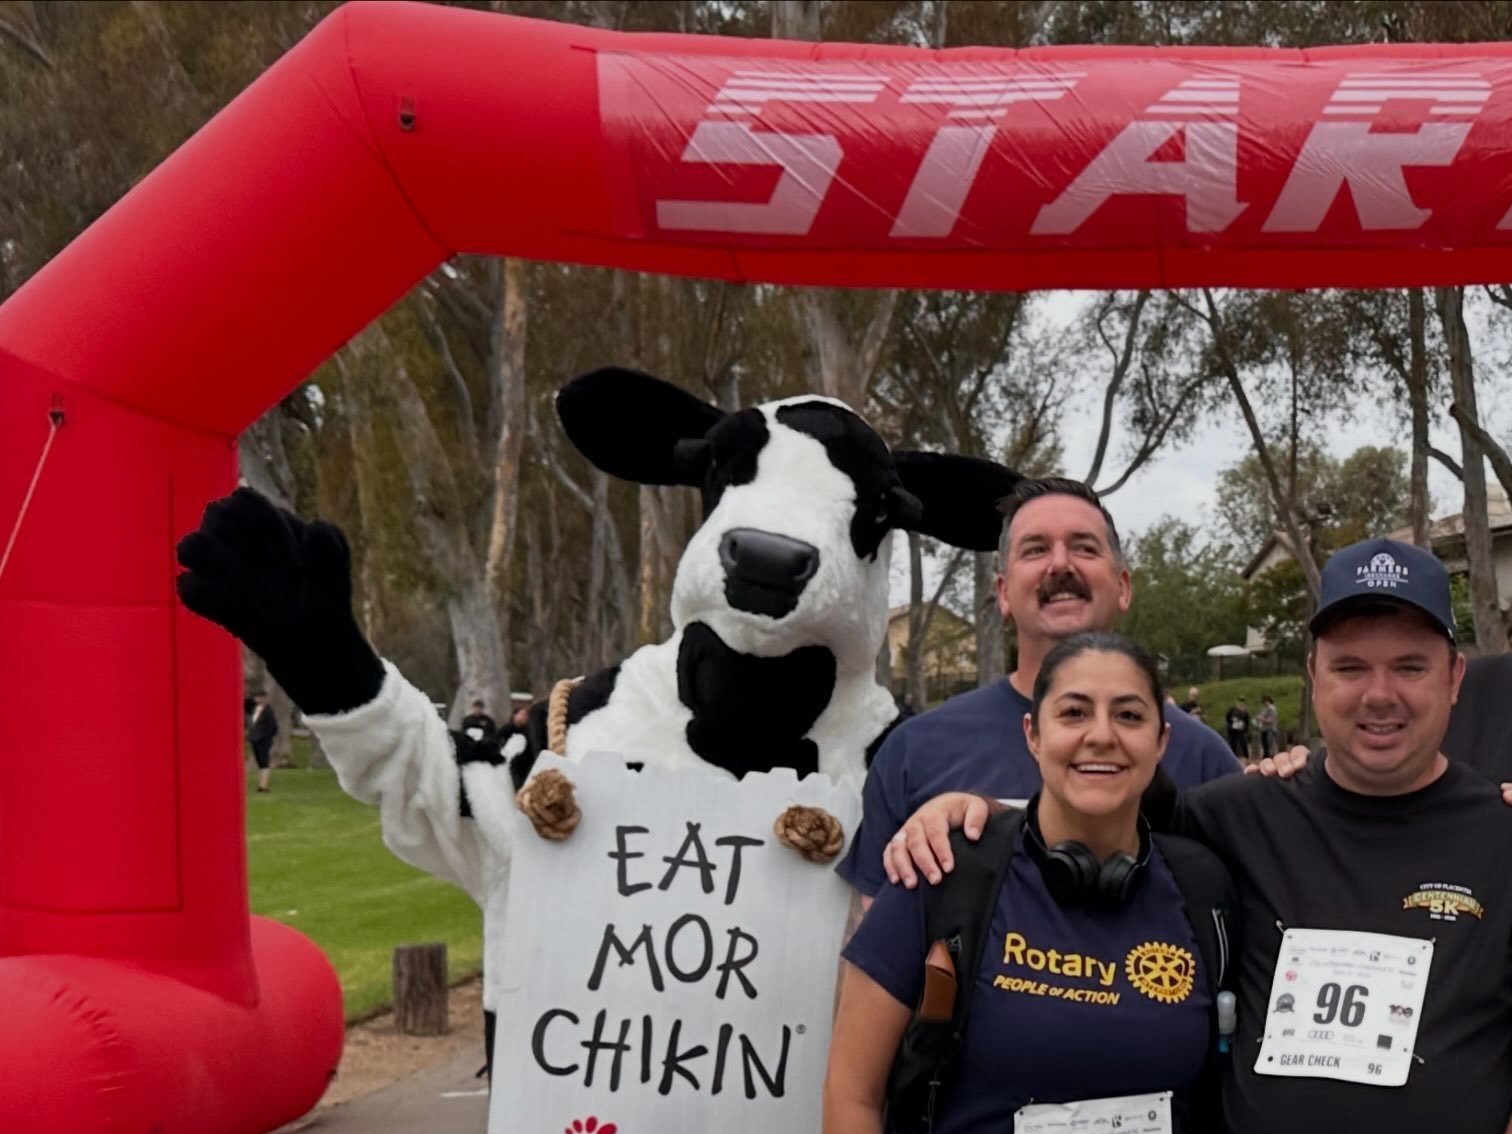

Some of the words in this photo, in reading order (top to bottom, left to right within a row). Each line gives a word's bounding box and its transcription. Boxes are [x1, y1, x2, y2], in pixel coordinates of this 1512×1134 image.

[1357, 565, 1408, 576] FARMERS
[1367, 580, 1397, 588] OPEN
[608, 822, 764, 904] EAT
[1430, 900, 1459, 915] 5K
[588, 913, 758, 999] MOR
[1003, 932, 1116, 986] Rotary
[993, 975, 1049, 996] PEOPLE
[1063, 988, 1120, 1005] ACTION
[1313, 982, 1369, 1027] 96
[1280, 1054, 1304, 1067] GEAR
[1308, 1055, 1341, 1069] CHECK
[1368, 1063, 1383, 1076] 96
